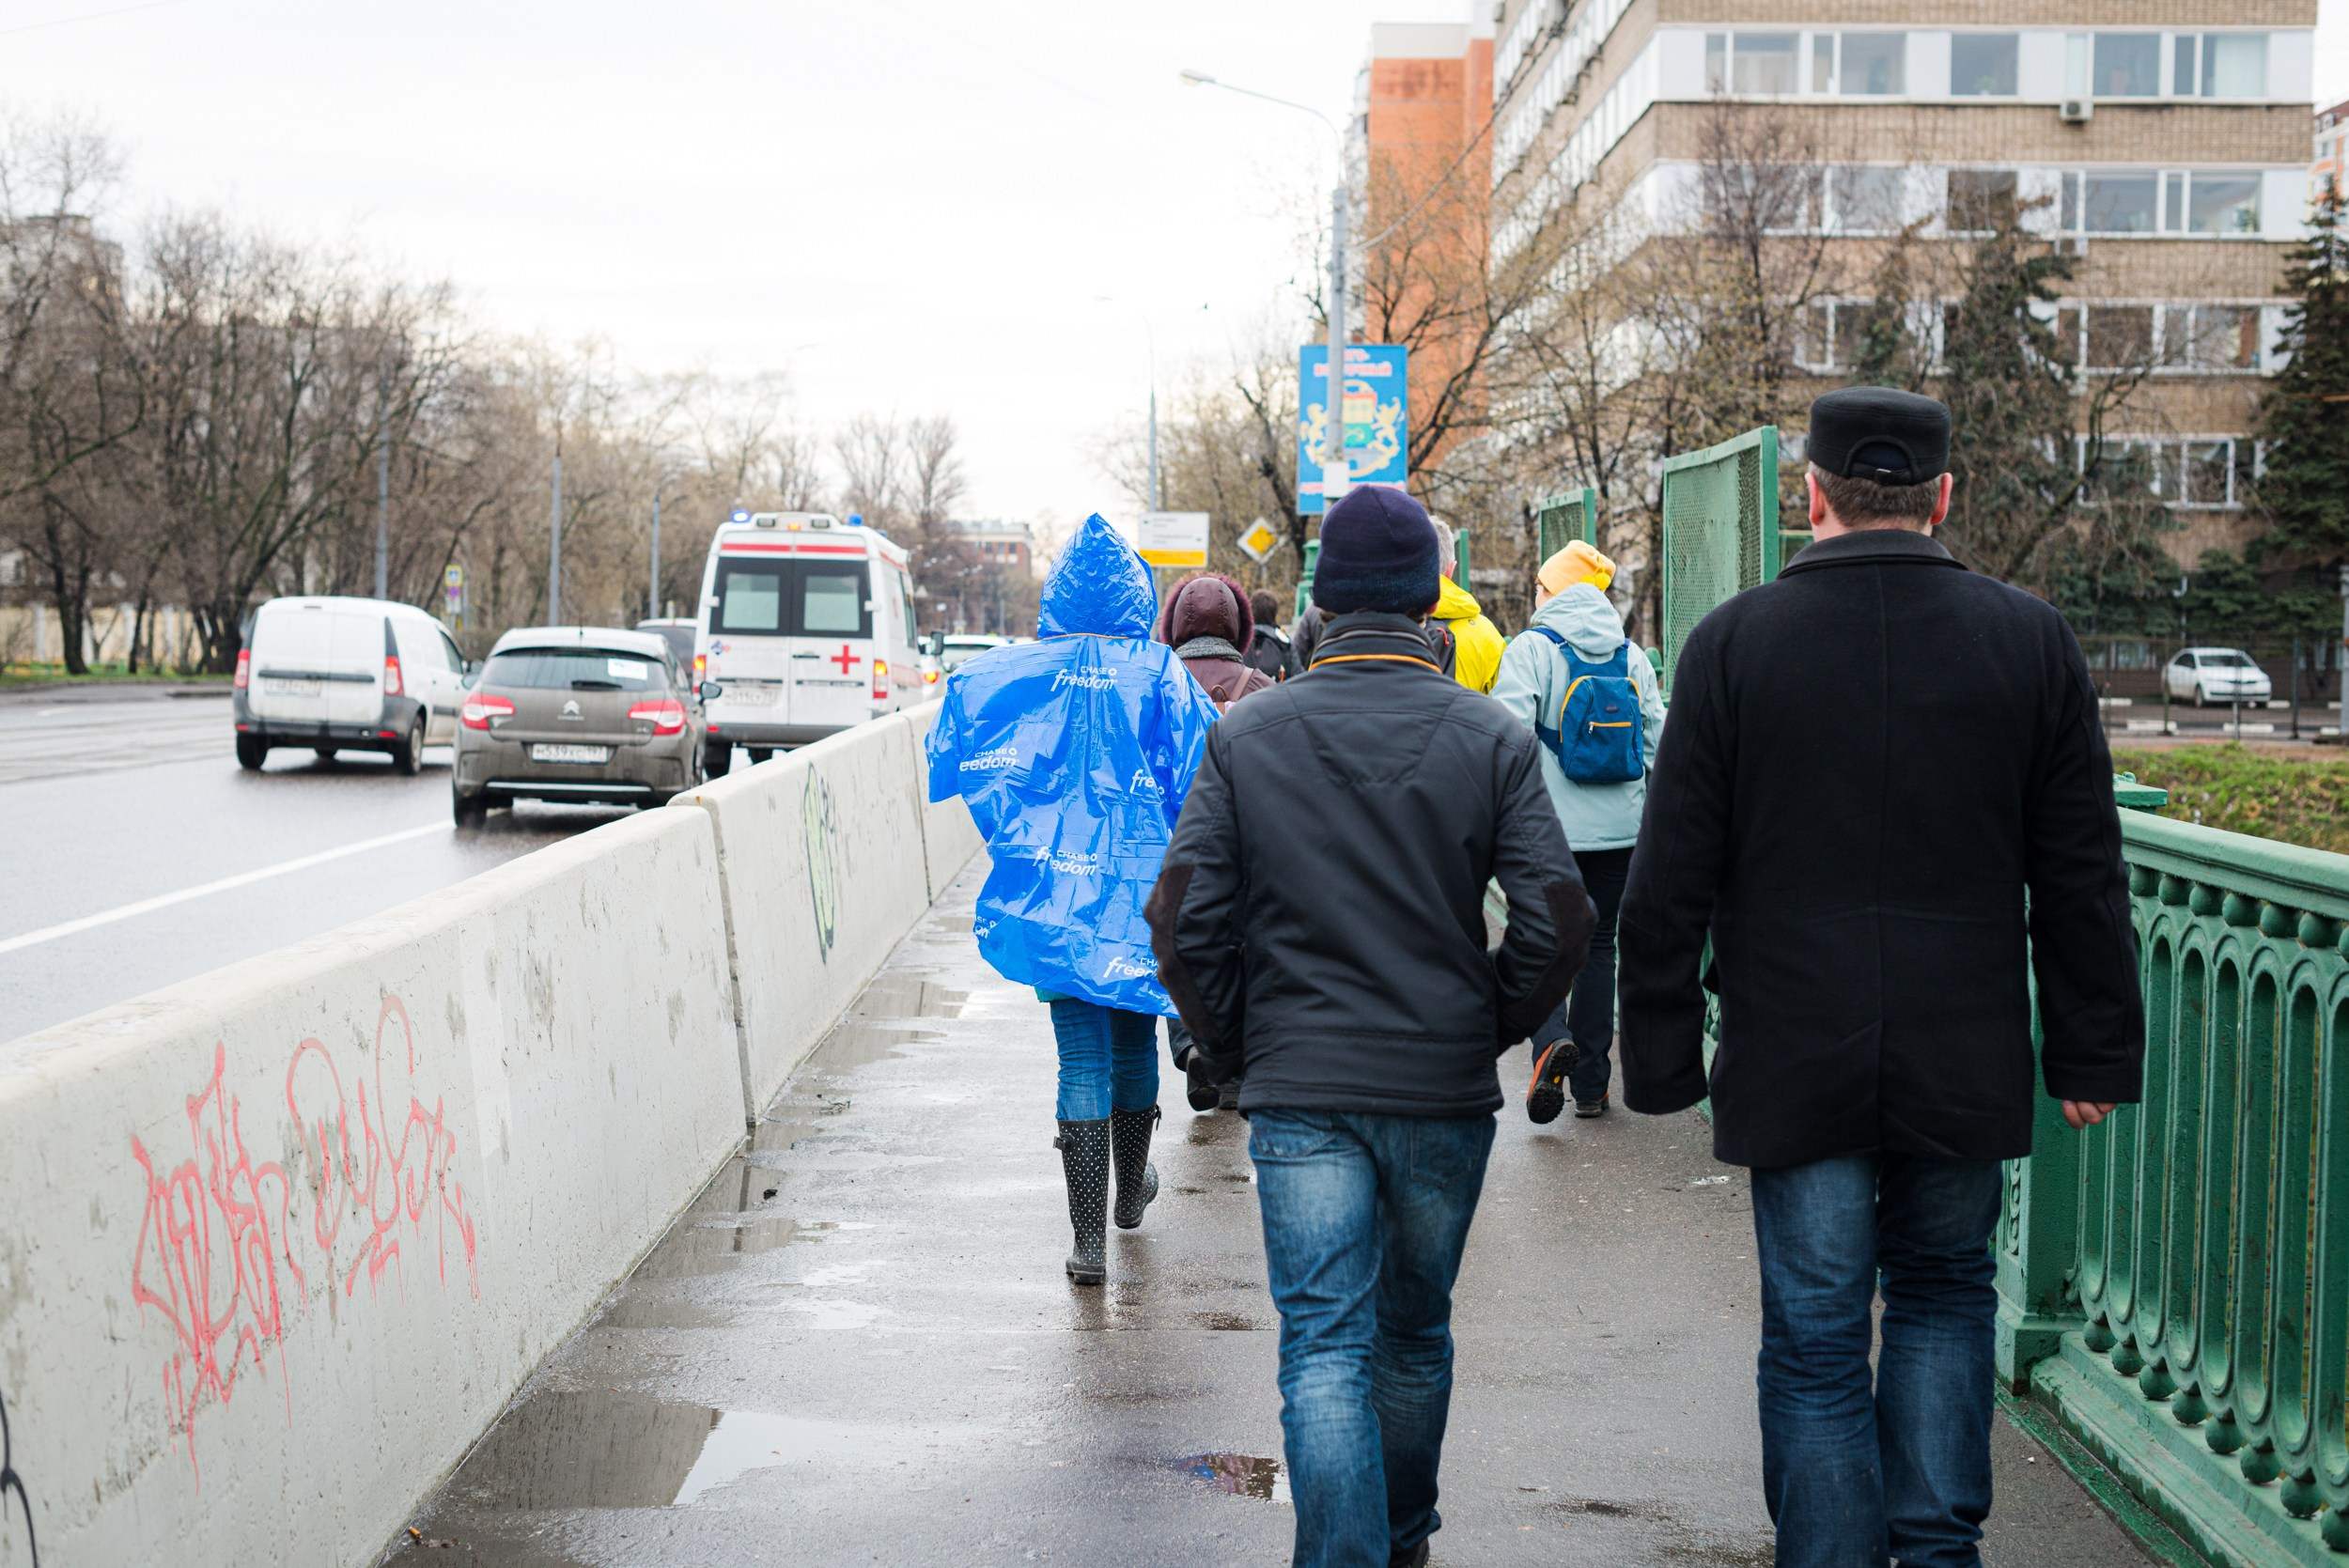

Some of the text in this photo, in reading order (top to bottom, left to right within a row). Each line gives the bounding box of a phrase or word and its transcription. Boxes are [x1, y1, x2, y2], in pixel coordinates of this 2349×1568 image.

[1080, 665, 1108, 675] CHASE
[1050, 668, 1114, 692] freedom
[974, 748, 1008, 758] CHASE
[958, 755, 1017, 772] eedom
[1056, 849, 1090, 862] CHASE
[1140, 957, 1159, 968] CHA
